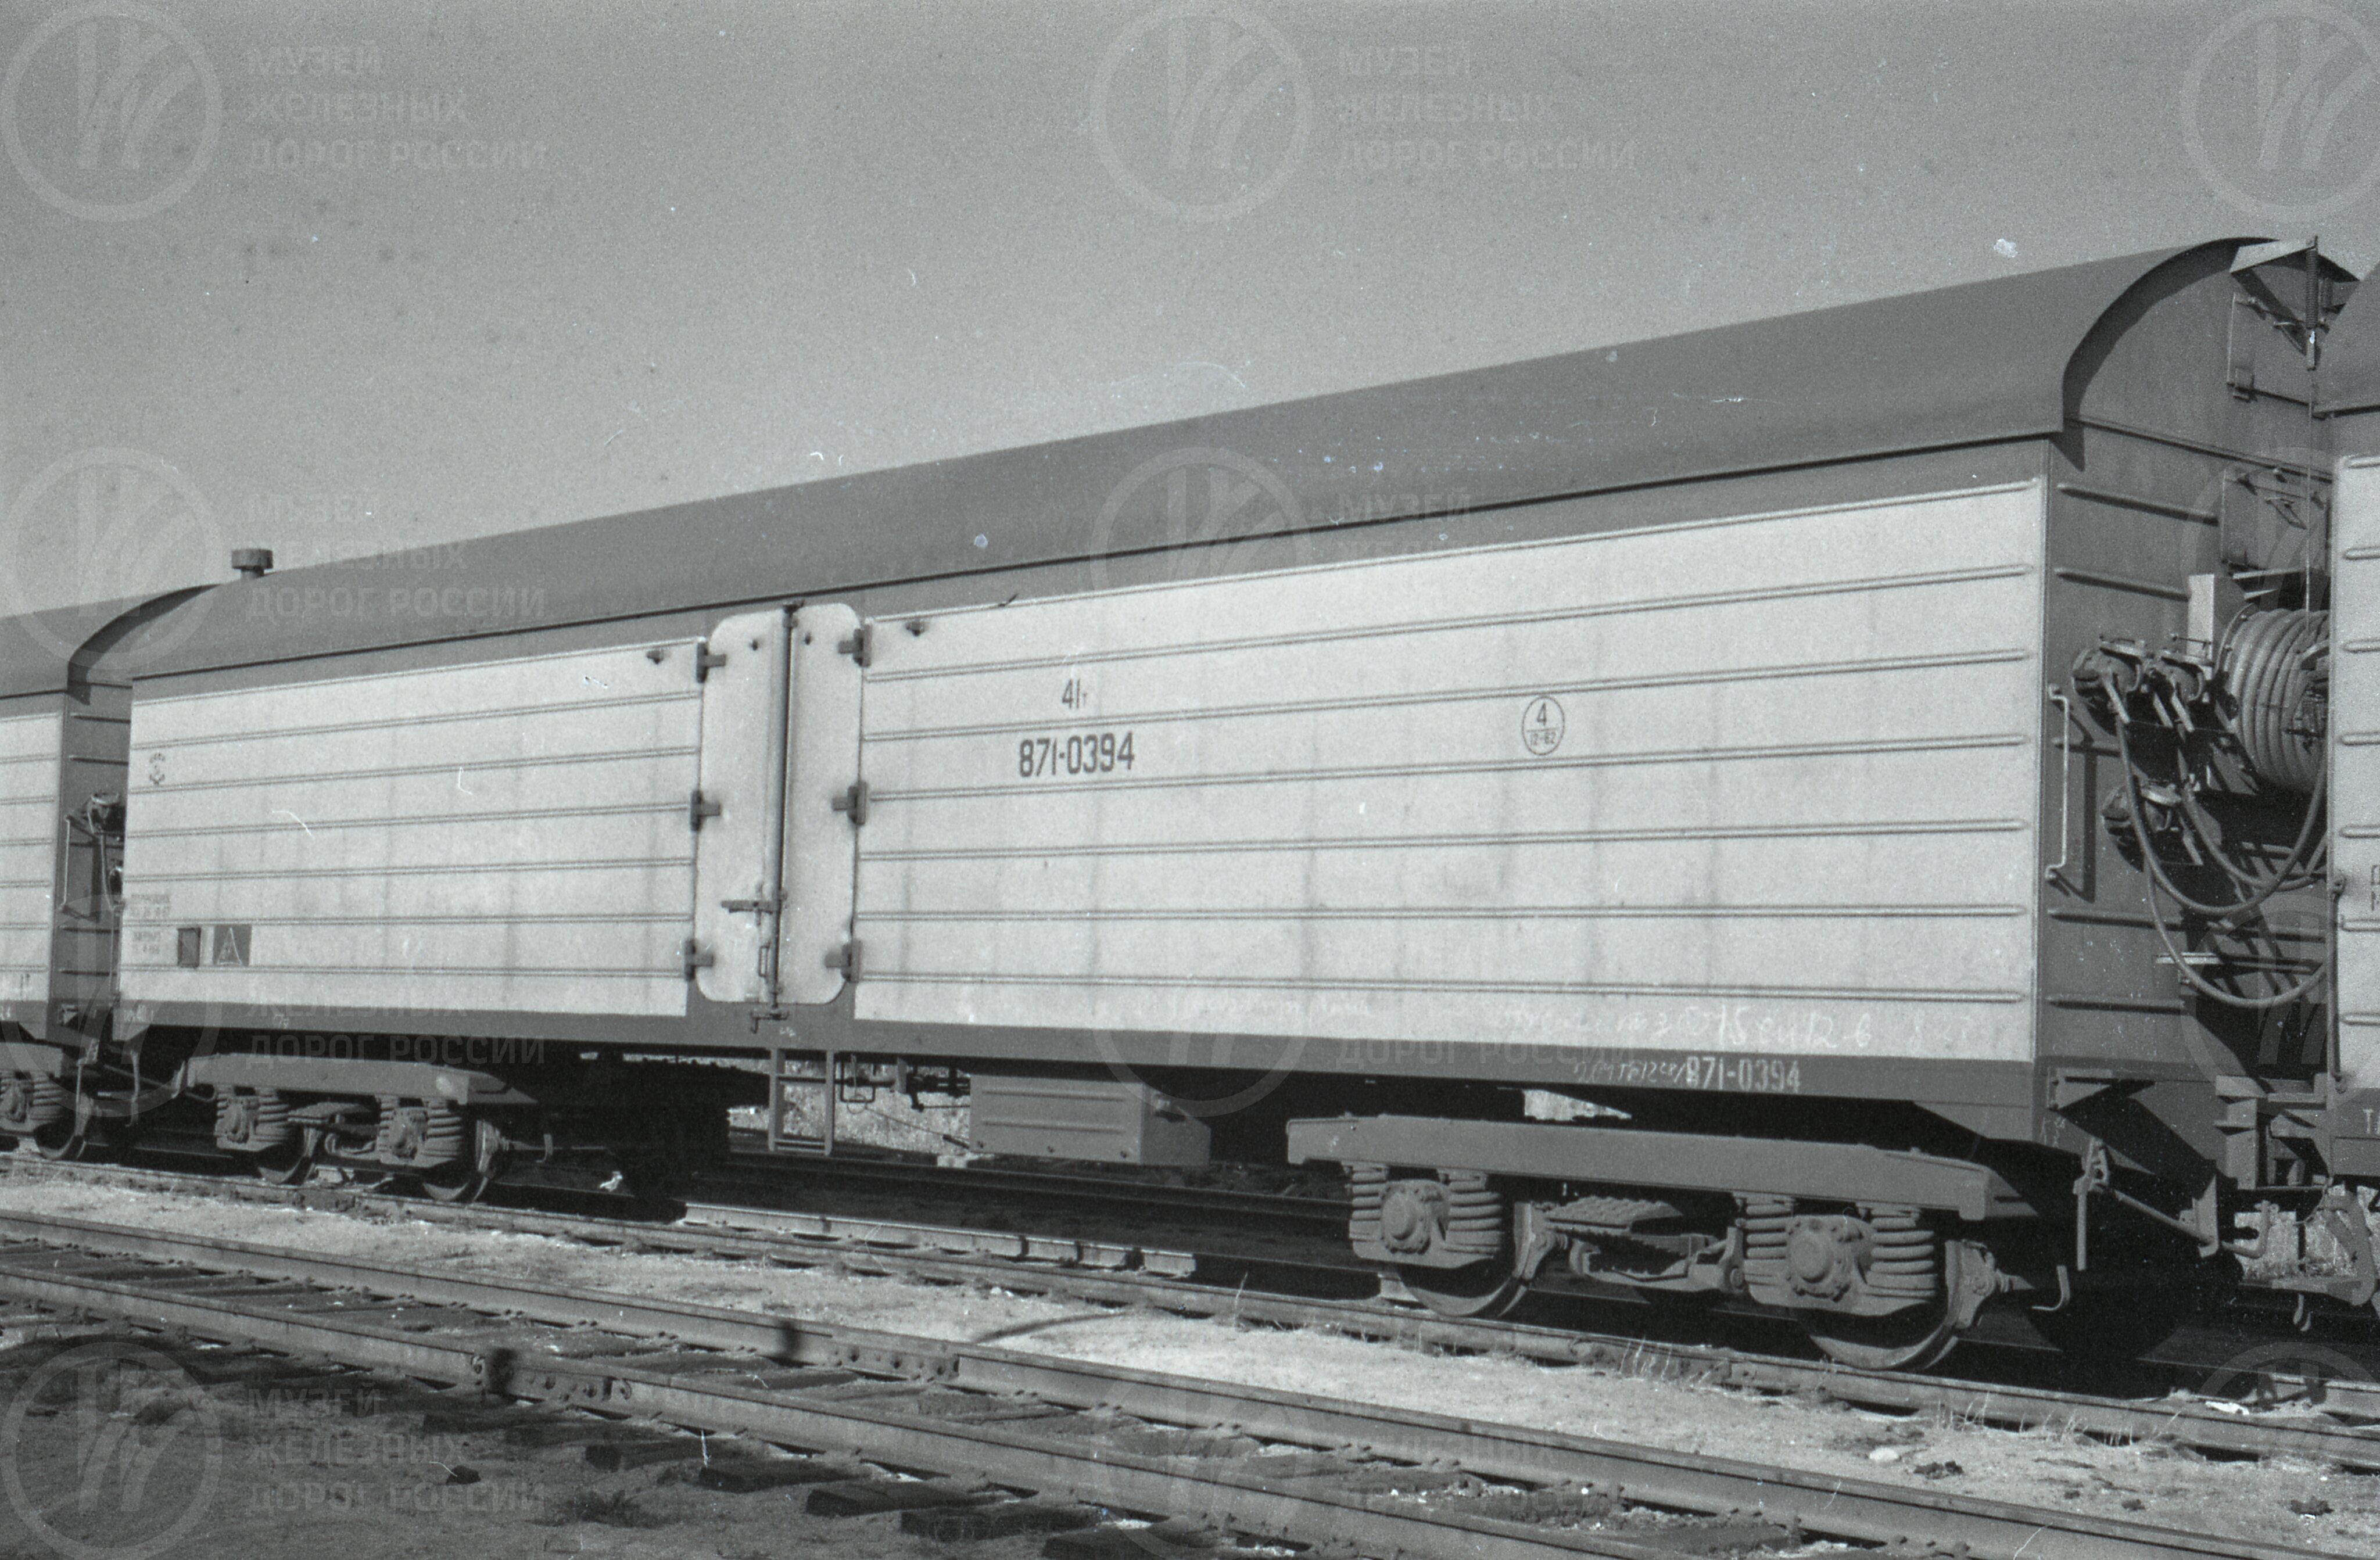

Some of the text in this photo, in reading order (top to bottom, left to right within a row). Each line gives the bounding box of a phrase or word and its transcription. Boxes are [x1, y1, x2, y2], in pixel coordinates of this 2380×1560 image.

[1536, 702, 1547, 726] 4
[1019, 731, 1135, 777] 871-0394
[1686, 1056, 1801, 1094] 871-0394
